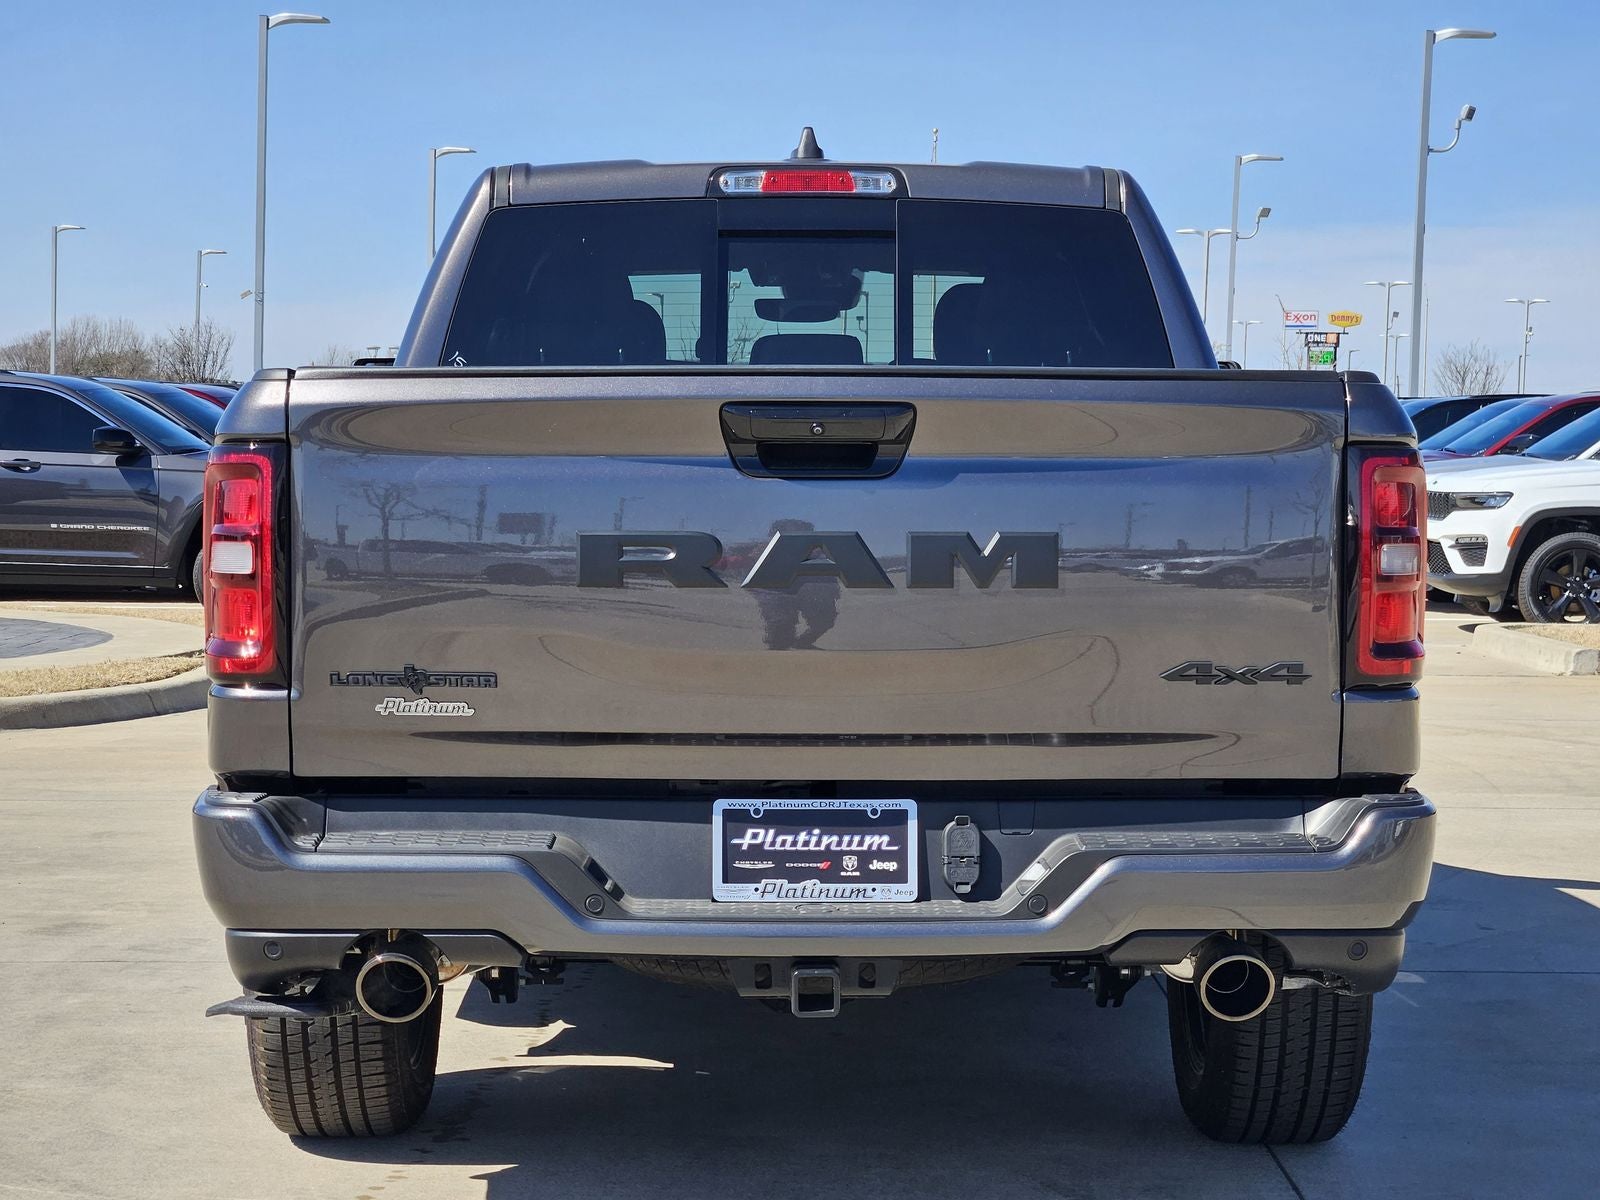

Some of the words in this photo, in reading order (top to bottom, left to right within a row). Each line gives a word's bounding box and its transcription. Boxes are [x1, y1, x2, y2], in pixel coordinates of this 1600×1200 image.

[1285, 312, 1316, 323] Exxon
[1331, 314, 1359, 323] Denny's
[576, 530, 1059, 588] RAM
[330, 671, 402, 687] LONE
[426, 672, 498, 688] STAR
[375, 697, 475, 716] Platinum
[727, 801, 902, 809] www.PlatinumCDRJTexas.com
[731, 828, 900, 850] Platinum
[869, 860, 898, 872] Jeep
[759, 882, 873, 899] Platinum
[894, 889, 914, 897] Jeep
